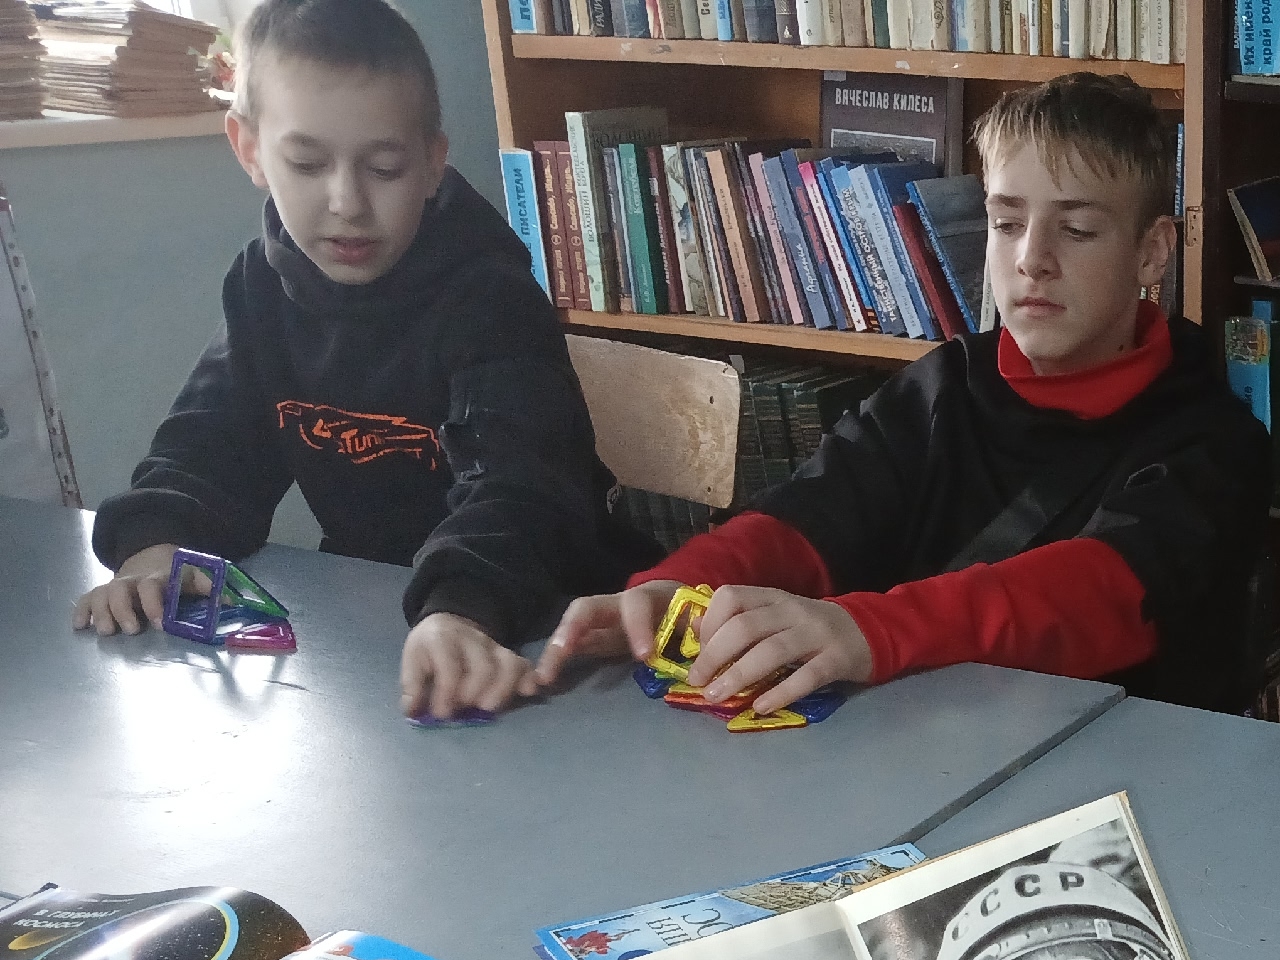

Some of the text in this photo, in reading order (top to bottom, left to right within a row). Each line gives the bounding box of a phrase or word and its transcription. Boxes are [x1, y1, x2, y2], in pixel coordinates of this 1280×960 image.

[1243, 45, 1255, 66] Их
[1259, 27, 1272, 65] край
[835, 87, 935, 114] ВЯЧЕСЛАВ КИЛЕСА
[512, 166, 530, 236] ПИСАТЕЛИ
[841, 187, 858, 216] КРЫМ
[951, 870, 1085, 942] СССР
